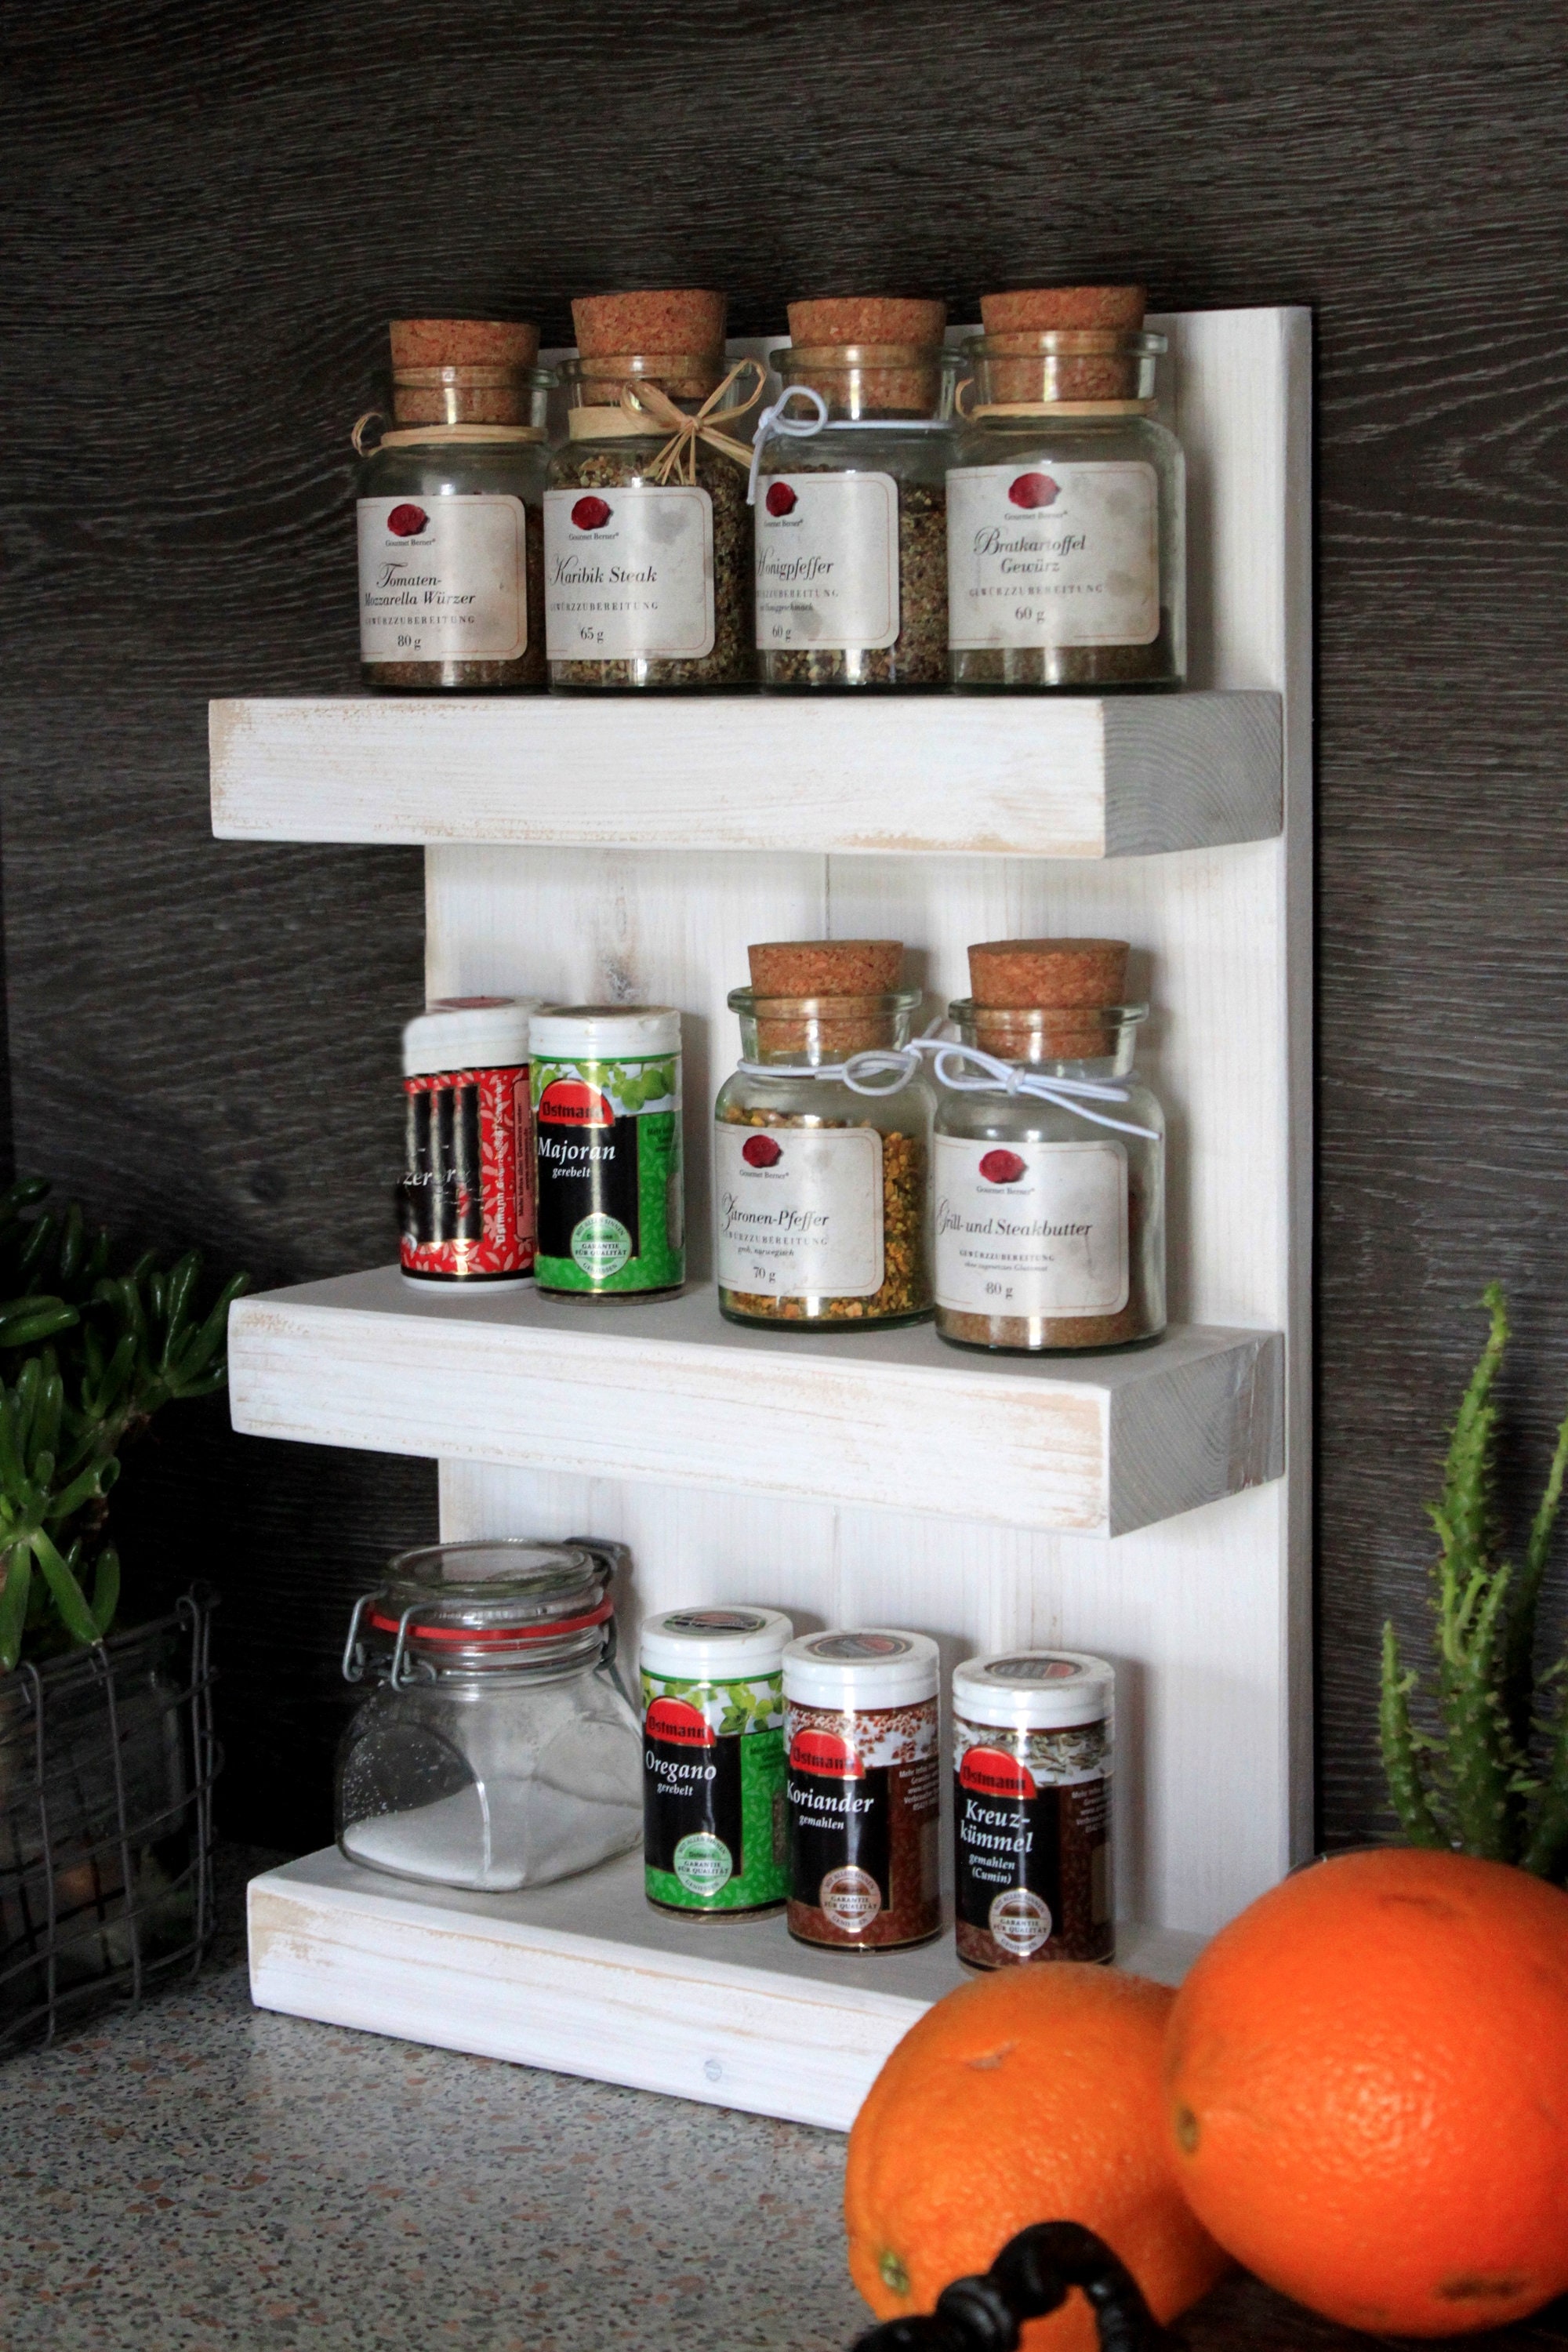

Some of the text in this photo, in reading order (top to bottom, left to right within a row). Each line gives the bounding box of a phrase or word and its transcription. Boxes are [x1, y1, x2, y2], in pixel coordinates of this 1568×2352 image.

[973, 526, 1086, 556] Bratkartoffel
[550, 554, 657, 586] Karibik Steak
[1000, 557, 1060, 574] Gewürz
[376, 562, 442, 589] Tomaten-
[365, 590, 476, 607] Mozzarella Würzer
[1014, 607, 1046, 623] 60 g
[397, 634, 421, 651] 80 g
[581, 626, 604, 644] 65 g
[786, 628, 792, 642] g
[543, 1101, 604, 1120] Ostmann
[538, 1137, 615, 1165] Majoran
[552, 1165, 590, 1179] gerebelt
[495, 1192, 506, 1243] Ostmann
[995, 1218, 1093, 1237] Steakbutter
[753, 1266, 776, 1283] 70 g
[986, 1282, 1013, 1298] 80 g
[648, 1715, 706, 1740] Ostmann
[645, 1750, 717, 1783] Oregano
[793, 1748, 855, 1770] Ostmann
[963, 1766, 1026, 1791] Ostmann
[657, 1782, 694, 1797] gerebelt
[786, 1780, 874, 1813] Koriander
[965, 1798, 1030, 1828] Kreuz-
[799, 1815, 845, 1831] gemahlen
[960, 1820, 1033, 1853] kümmel
[969, 1853, 1015, 1870] gemahlen
[972, 1867, 1011, 1885] (Cumin)
